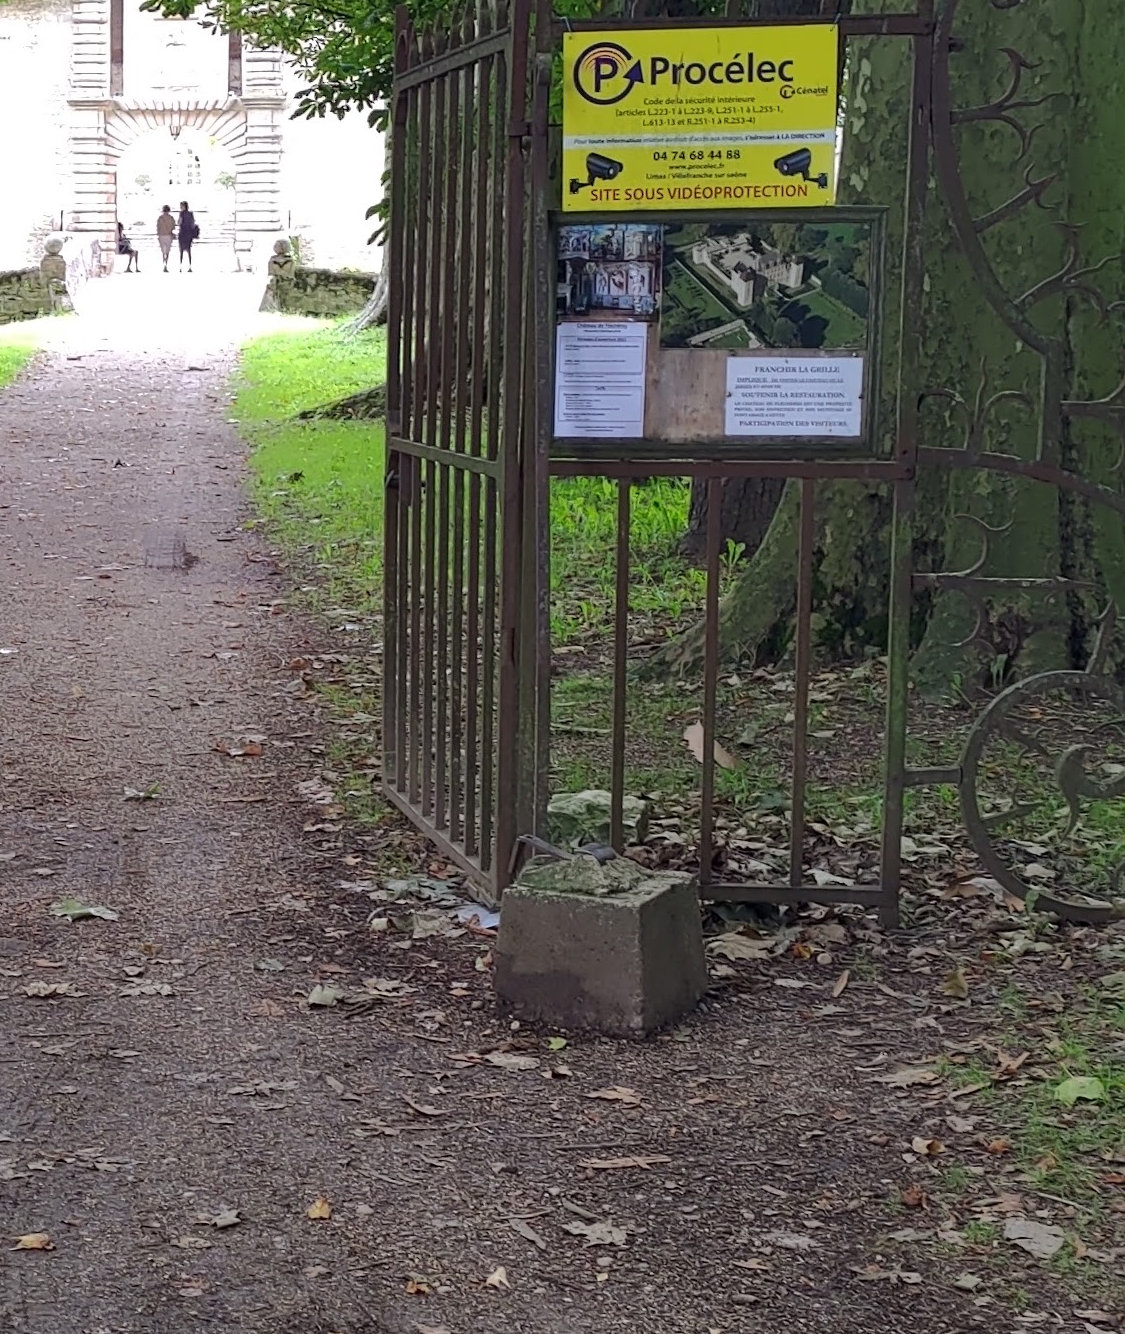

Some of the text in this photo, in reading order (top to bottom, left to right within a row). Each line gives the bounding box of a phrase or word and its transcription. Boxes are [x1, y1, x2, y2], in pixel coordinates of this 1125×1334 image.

[650, 52, 794, 86] Procélec
[653, 150, 740, 160] 04 74 68 44 88
[590, 184, 808, 201] SITE SOUS VIDÉOPROTECTION
